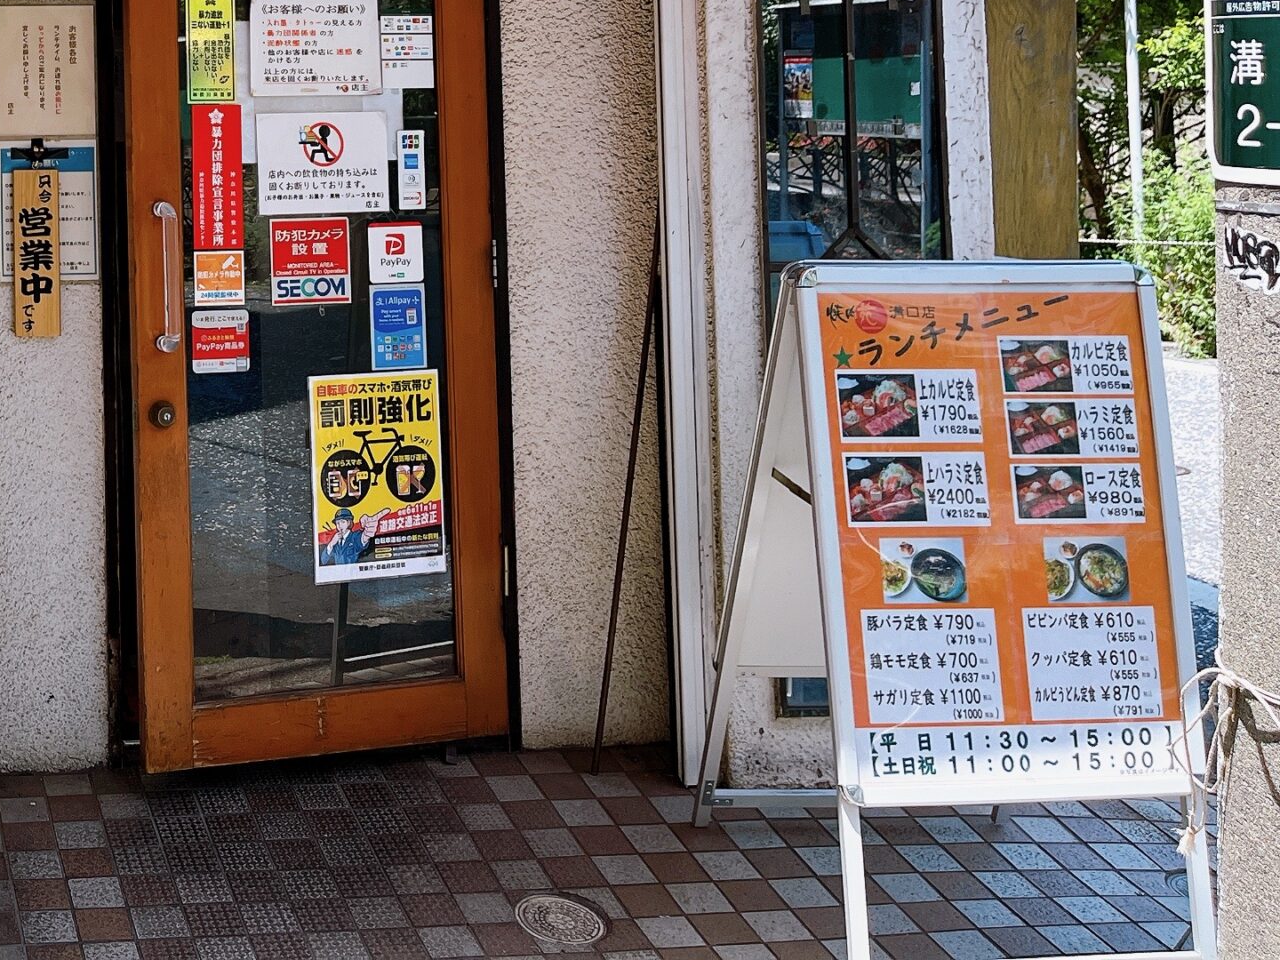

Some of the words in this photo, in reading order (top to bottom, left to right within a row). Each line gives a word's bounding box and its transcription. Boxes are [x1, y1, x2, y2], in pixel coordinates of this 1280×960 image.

[261, 4, 366, 15] 《お客様へのお願い》
[1230, 39, 1265, 85] 溝
[268, 168, 378, 179] 店内への飲食物の持ち込みは
[38, 174, 52, 203] 只今
[269, 180, 366, 191] 固くお断りしております。
[275, 228, 344, 242] 防犯カメラ
[19, 206, 53, 304] 営業中
[291, 242, 328, 255] 設置
[380, 257, 412, 268] PayPay
[277, 278, 346, 298] SECOM
[23, 303, 35, 332] です
[889, 305, 936, 319] 溝口店
[858, 295, 1069, 366] ランチメニュー
[1071, 340, 1128, 362] カルビ定食
[1073, 363, 1118, 377] ¥1050
[317, 378, 432, 397] 自転車のスマホ・酒気帯び
[919, 377, 976, 401] 上カルビ定食
[320, 394, 431, 428] 罰則強化
[921, 404, 966, 421] ¥1790
[1078, 404, 1133, 425] ハラミ定食
[1080, 427, 1124, 440] ¥1560
[926, 461, 983, 485] 上ハラミ定食
[1085, 467, 1141, 488] ロース定食
[927, 488, 974, 505] ¥2400
[1088, 491, 1132, 504] ¥980
[867, 614, 928, 631] 豚バラ定食
[933, 614, 974, 630] ¥790
[1094, 612, 1133, 628] ¥610
[870, 652, 931, 670] 鶏モモ定食
[937, 652, 977, 668] ¥700
[1032, 650, 1092, 666] クッパ定食
[1097, 649, 1137, 666] ¥610
[873, 688, 935, 705] サガリ定食
[940, 688, 981, 704] ¥1100
[1035, 686, 1096, 702] カルビうどん定食
[1100, 685, 1140, 701] ¥870
